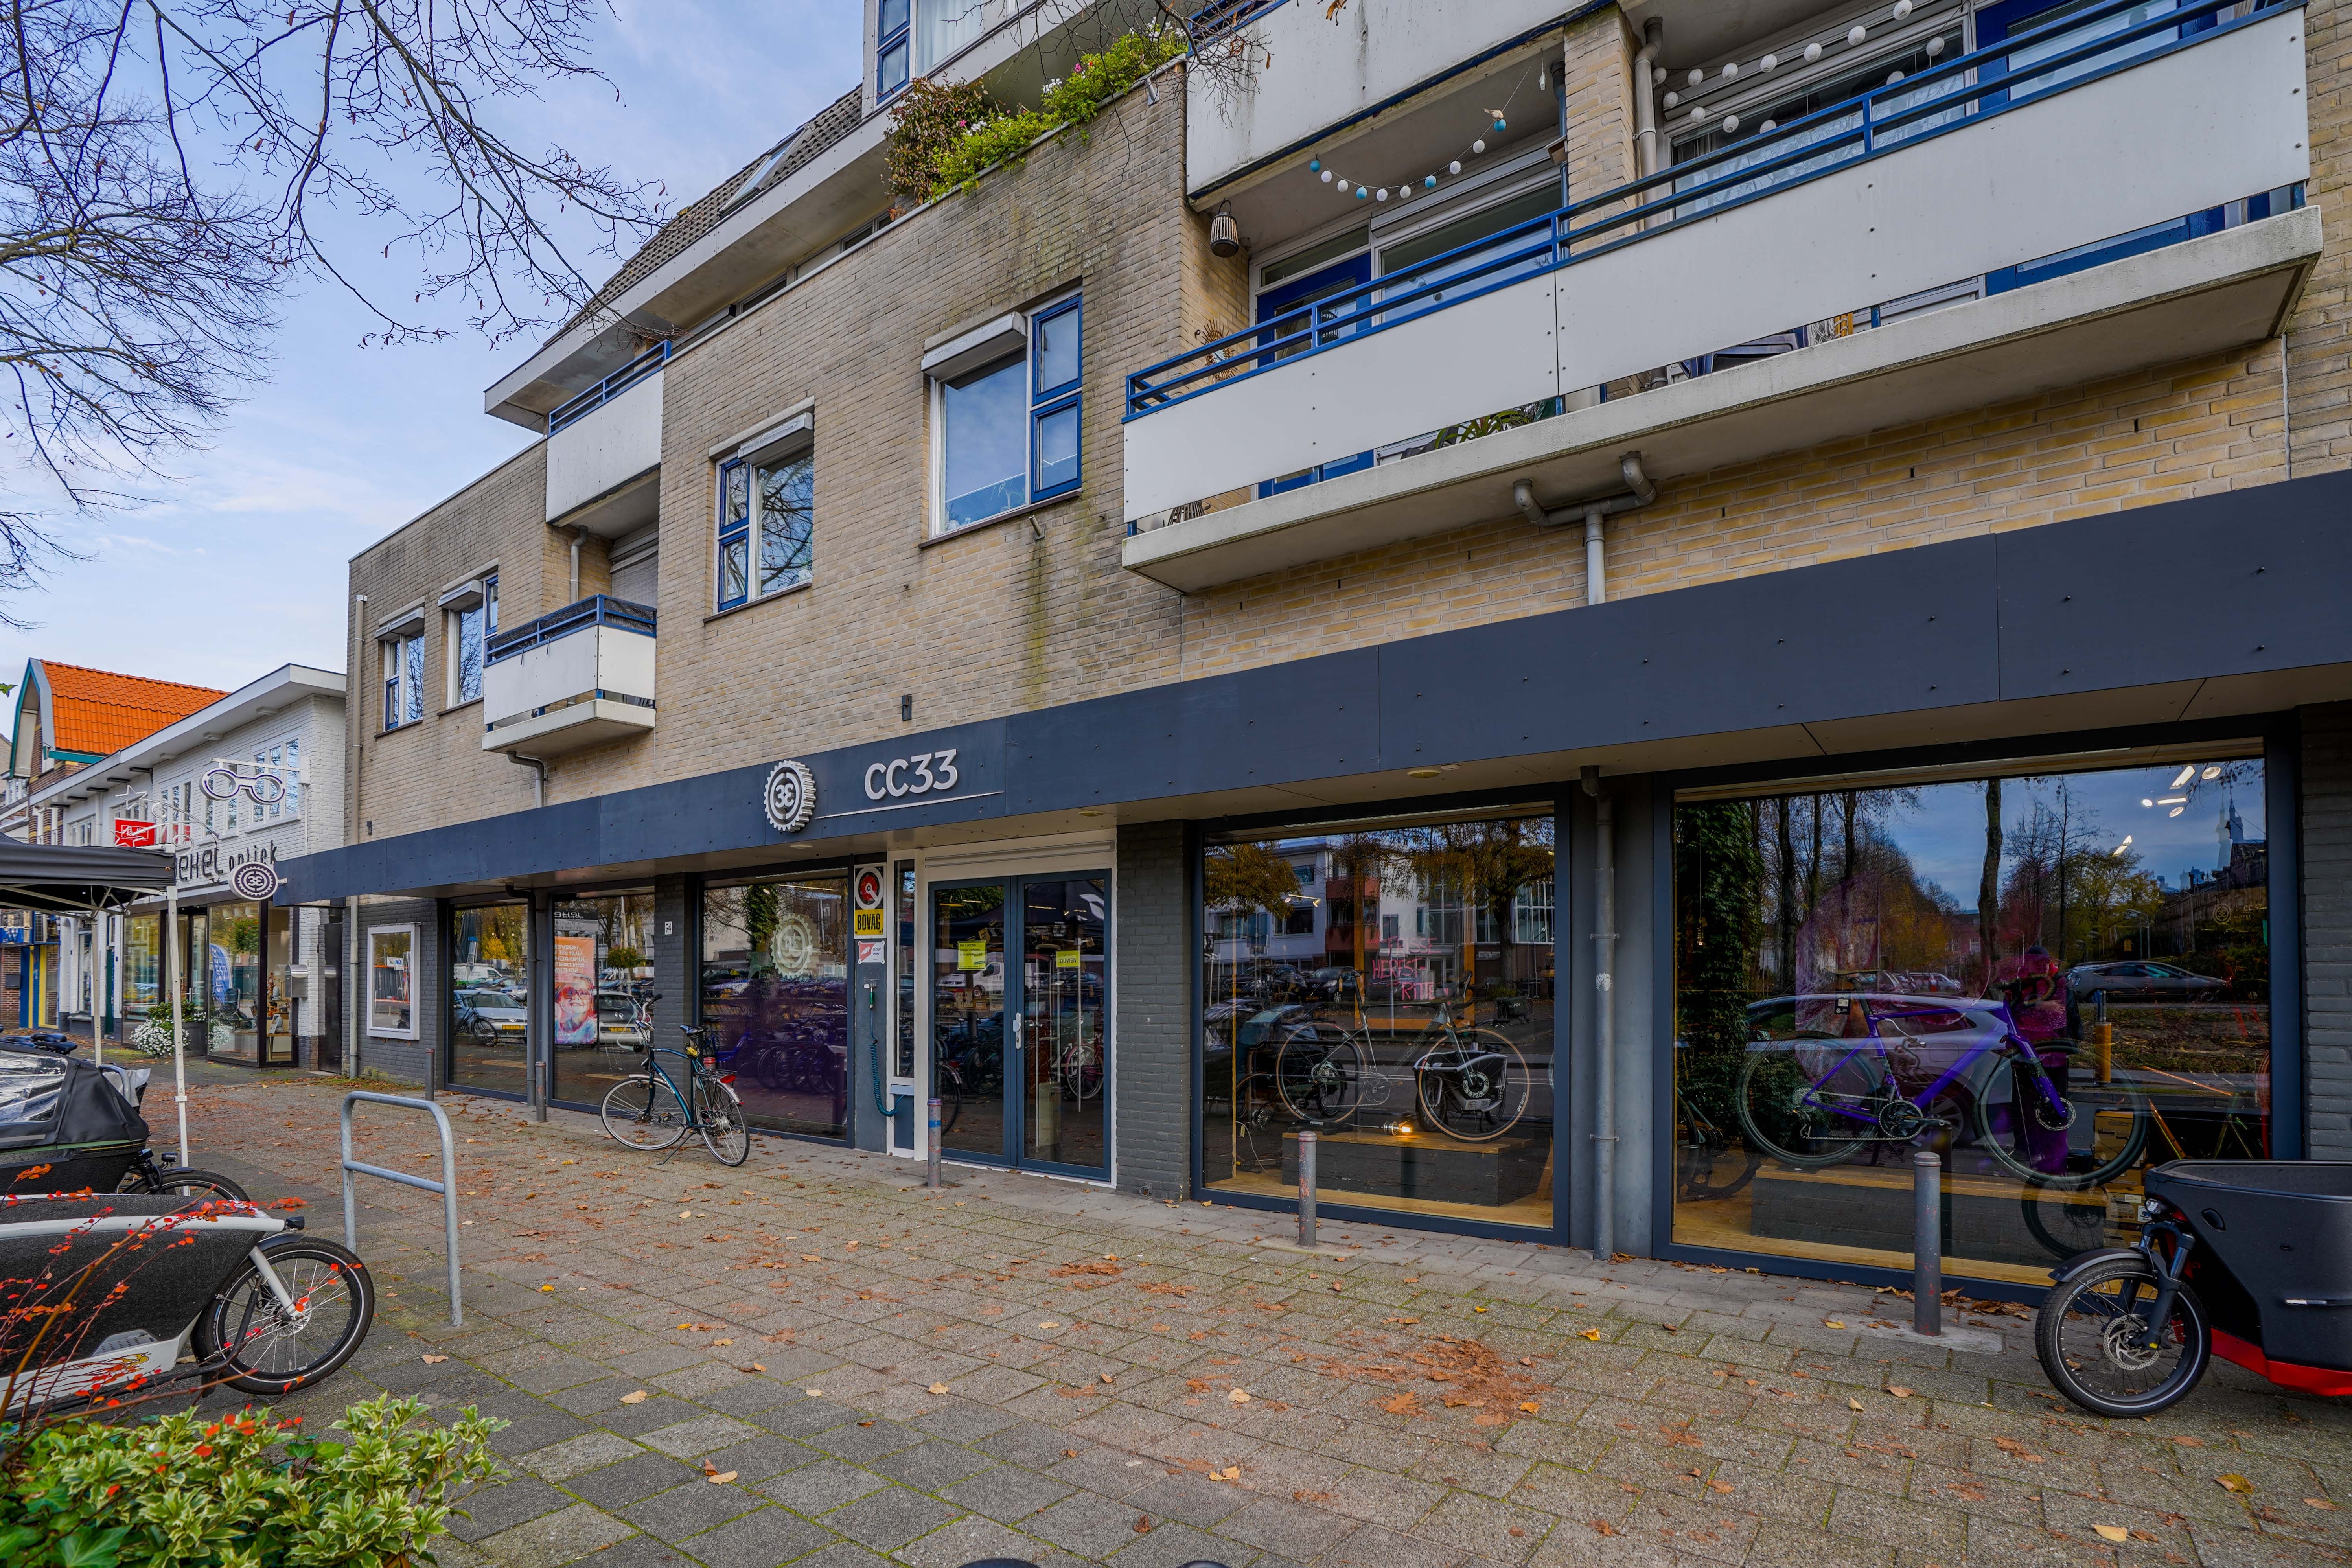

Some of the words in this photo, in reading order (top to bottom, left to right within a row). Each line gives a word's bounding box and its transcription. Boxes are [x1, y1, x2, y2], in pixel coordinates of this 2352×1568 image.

[865, 749, 958, 800] CC33
[666, 924, 671, 932] 94
[858, 913, 880, 931] BOVAG
[1388, 936, 1441, 956] FRISSE
[1394, 1033, 1426, 1071] cannondale
